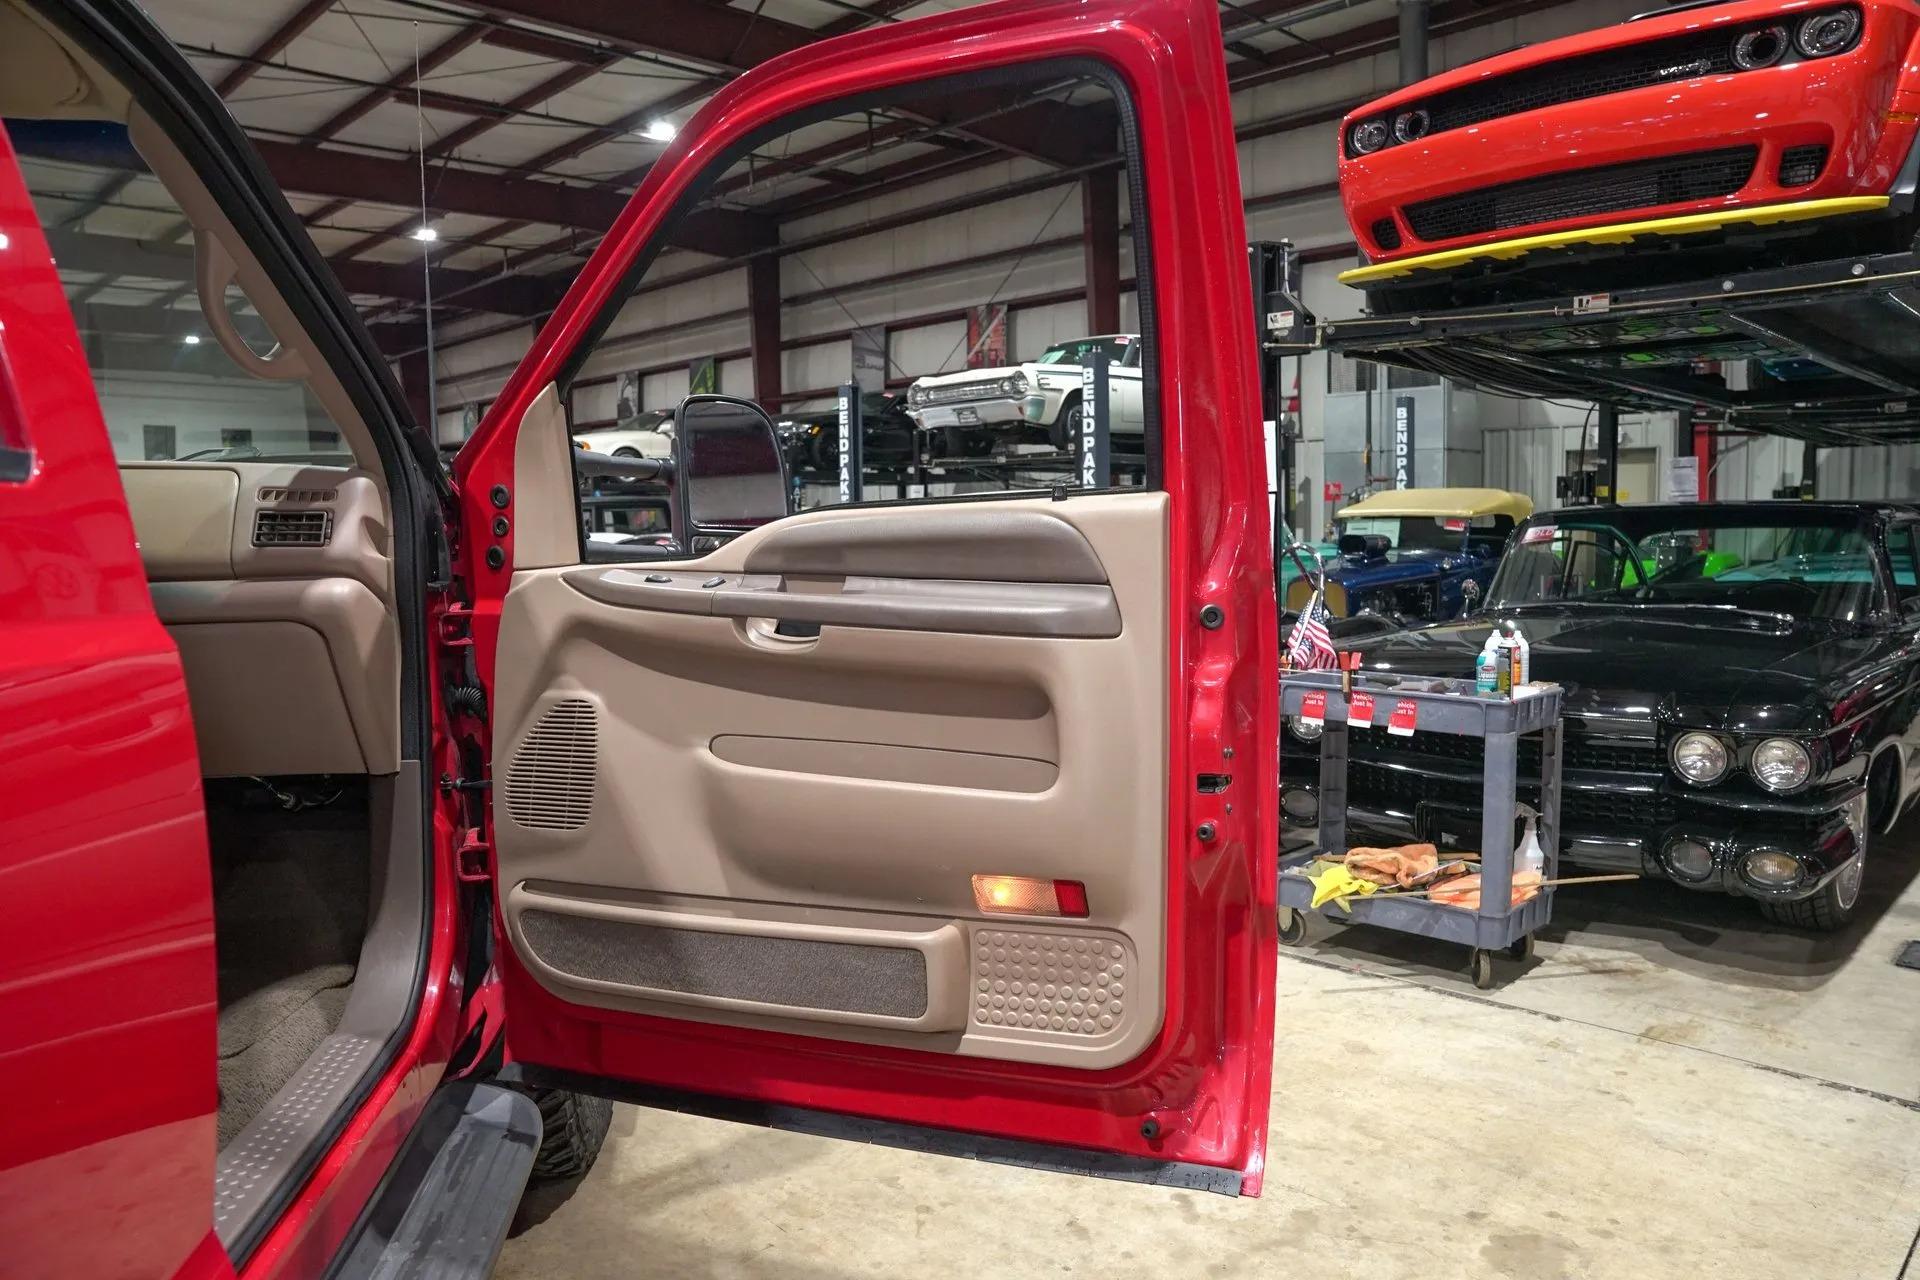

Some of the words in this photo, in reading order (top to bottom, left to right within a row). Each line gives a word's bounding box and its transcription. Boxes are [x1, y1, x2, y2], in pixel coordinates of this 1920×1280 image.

[839, 397, 850, 494] BENDPAK
[1083, 367, 1096, 485] BENDPAK
[1396, 407, 1408, 490] BENDPAK
